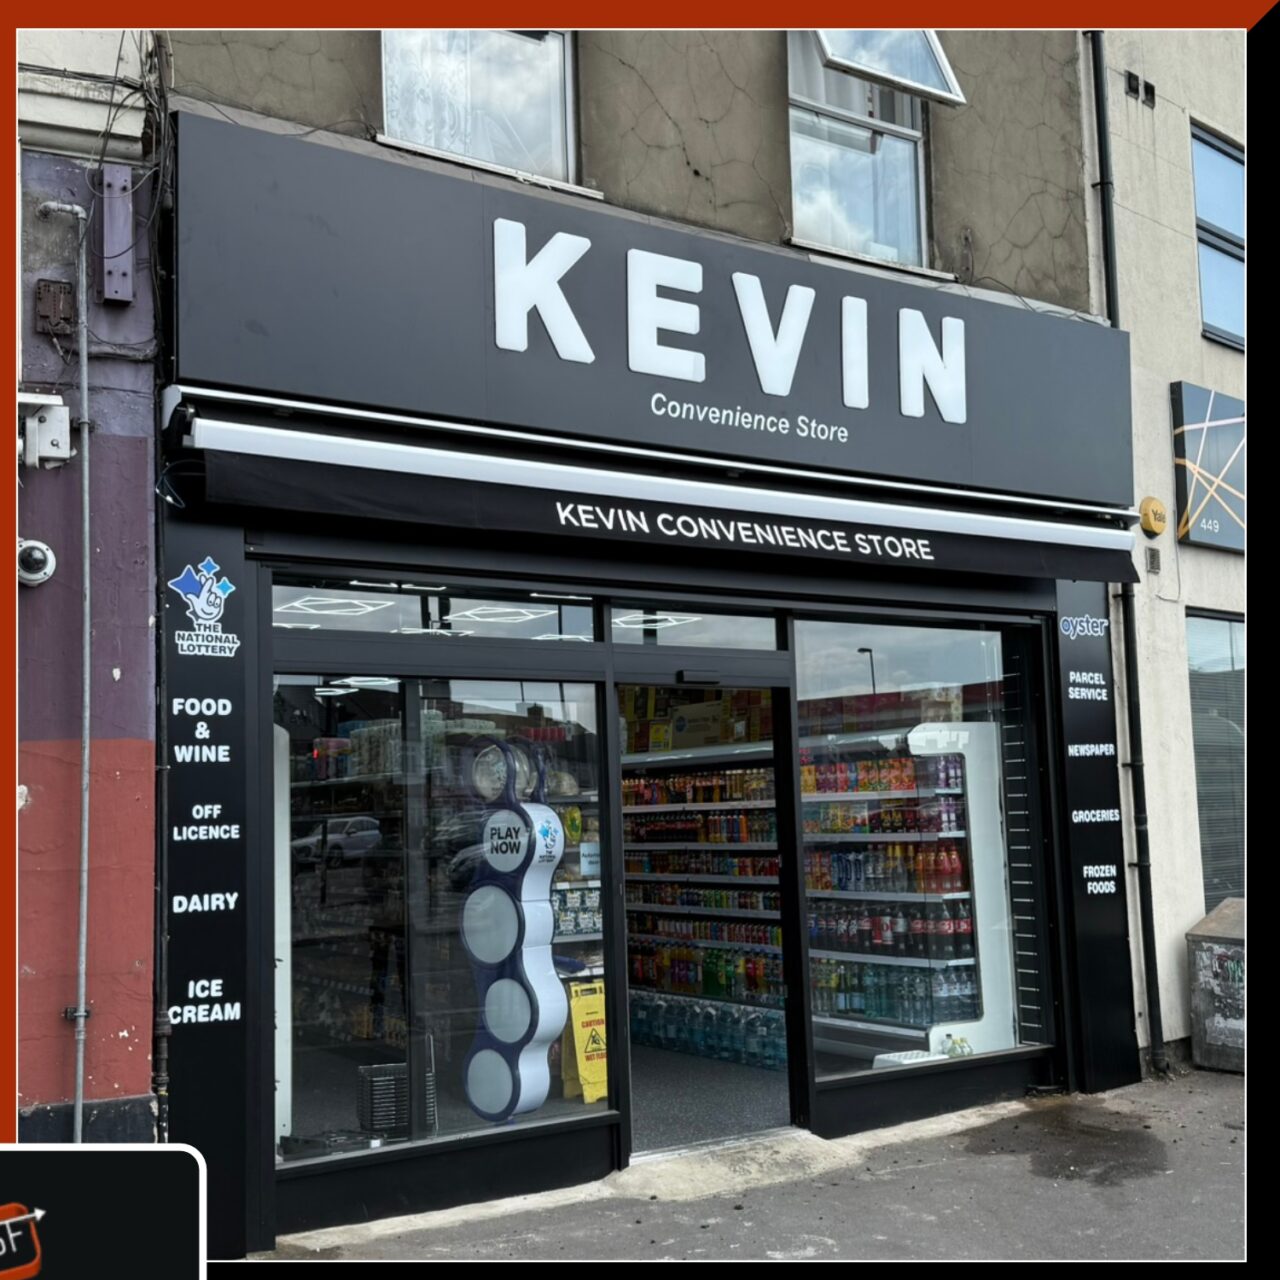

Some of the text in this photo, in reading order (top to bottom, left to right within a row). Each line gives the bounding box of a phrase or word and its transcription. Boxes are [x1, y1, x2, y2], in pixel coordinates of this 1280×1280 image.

[494, 217, 967, 424] KEVIN
[650, 392, 849, 443] Convenience Store
[556, 502, 935, 561] KEVIN CONVENIENCE STORE
[1200, 518, 1220, 533] 449
[195, 623, 220, 633] THE
[1061, 615, 1107, 639] oyster
[176, 632, 239, 645] NATIONAL
[179, 643, 236, 655] LOTTERY
[1069, 671, 1106, 684] PARCEL
[1068, 686, 1108, 700] SERVICE
[172, 698, 233, 716] FOOD
[195, 721, 211, 739] &
[174, 745, 231, 763] WINE
[1068, 744, 1115, 756] NEWSPAPER
[192, 804, 222, 819] OFF
[1072, 810, 1120, 823] GROCERIES
[173, 824, 240, 841] LICENCE
[490, 827, 521, 840] PLAY
[490, 841, 521, 854] NOW
[1083, 865, 1116, 878] FROZEN
[1087, 880, 1116, 894] FOODS
[173, 892, 239, 913] DAIRY
[188, 979, 223, 998] ICE
[168, 1002, 241, 1024] CREAM
